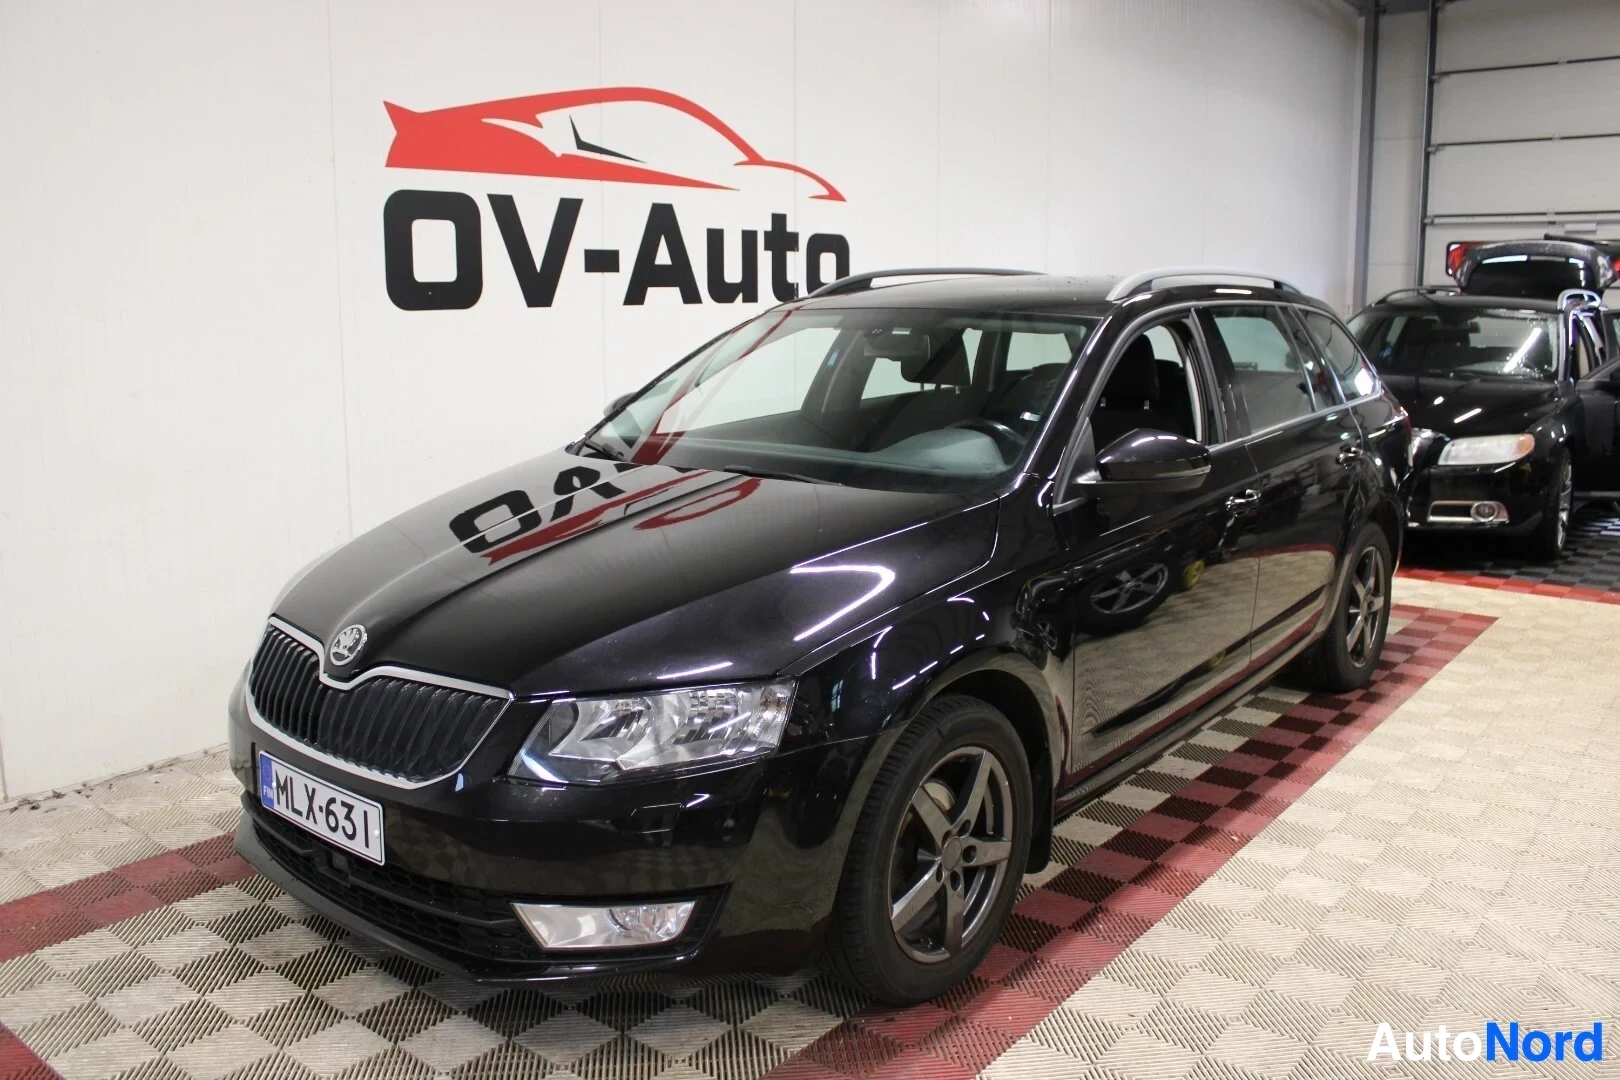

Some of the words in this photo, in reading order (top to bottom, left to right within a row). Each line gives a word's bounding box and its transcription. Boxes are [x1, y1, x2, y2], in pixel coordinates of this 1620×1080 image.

[383, 189, 850, 311] OV-Auto
[263, 785, 275, 800] FIN
[275, 769, 370, 849] MLX-631
